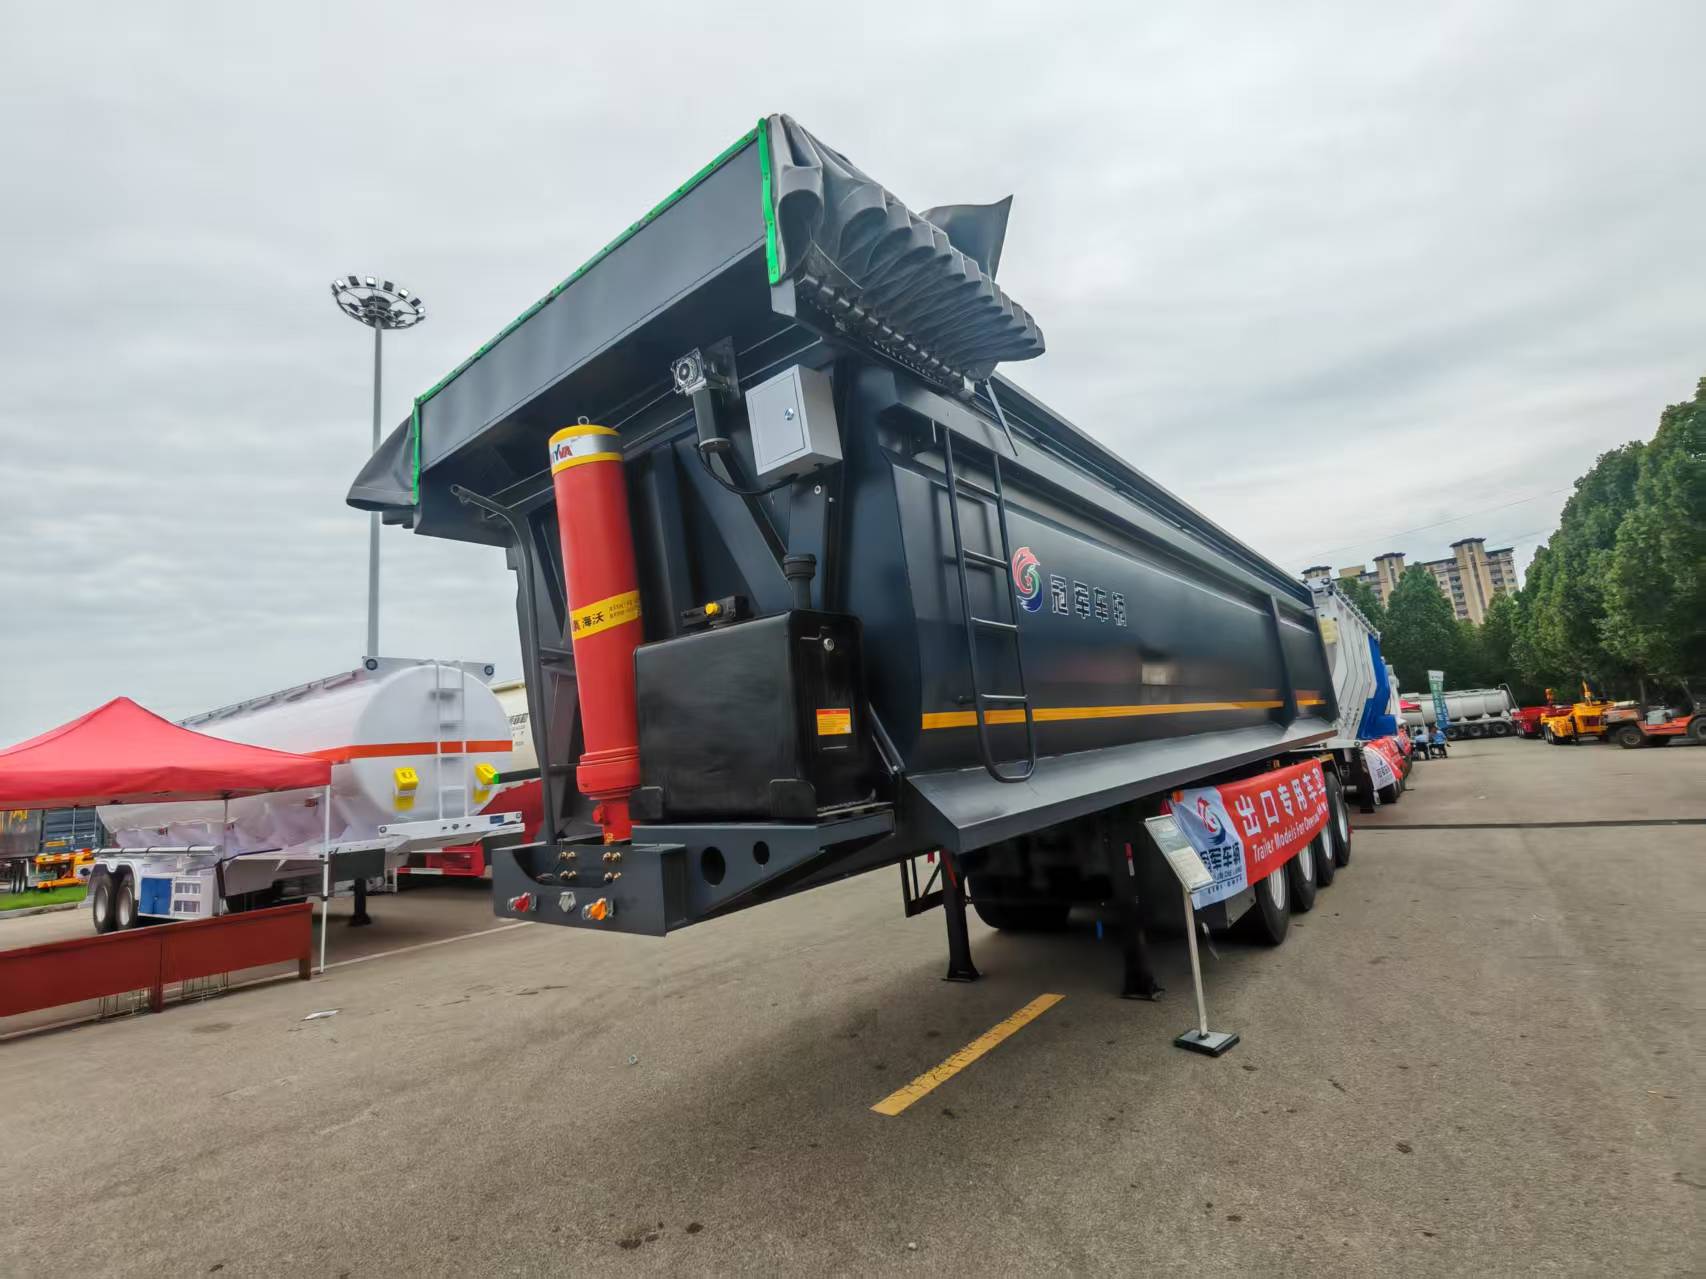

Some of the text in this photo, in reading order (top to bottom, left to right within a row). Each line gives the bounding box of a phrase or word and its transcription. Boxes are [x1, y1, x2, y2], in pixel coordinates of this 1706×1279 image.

[552, 444, 573, 461] YVA
[1050, 574, 1127, 627] 冠军车辆
[1234, 767, 1326, 837] 出口专用车型
[1252, 841, 1273, 863] Trailer
[1274, 827, 1297, 849] Models
